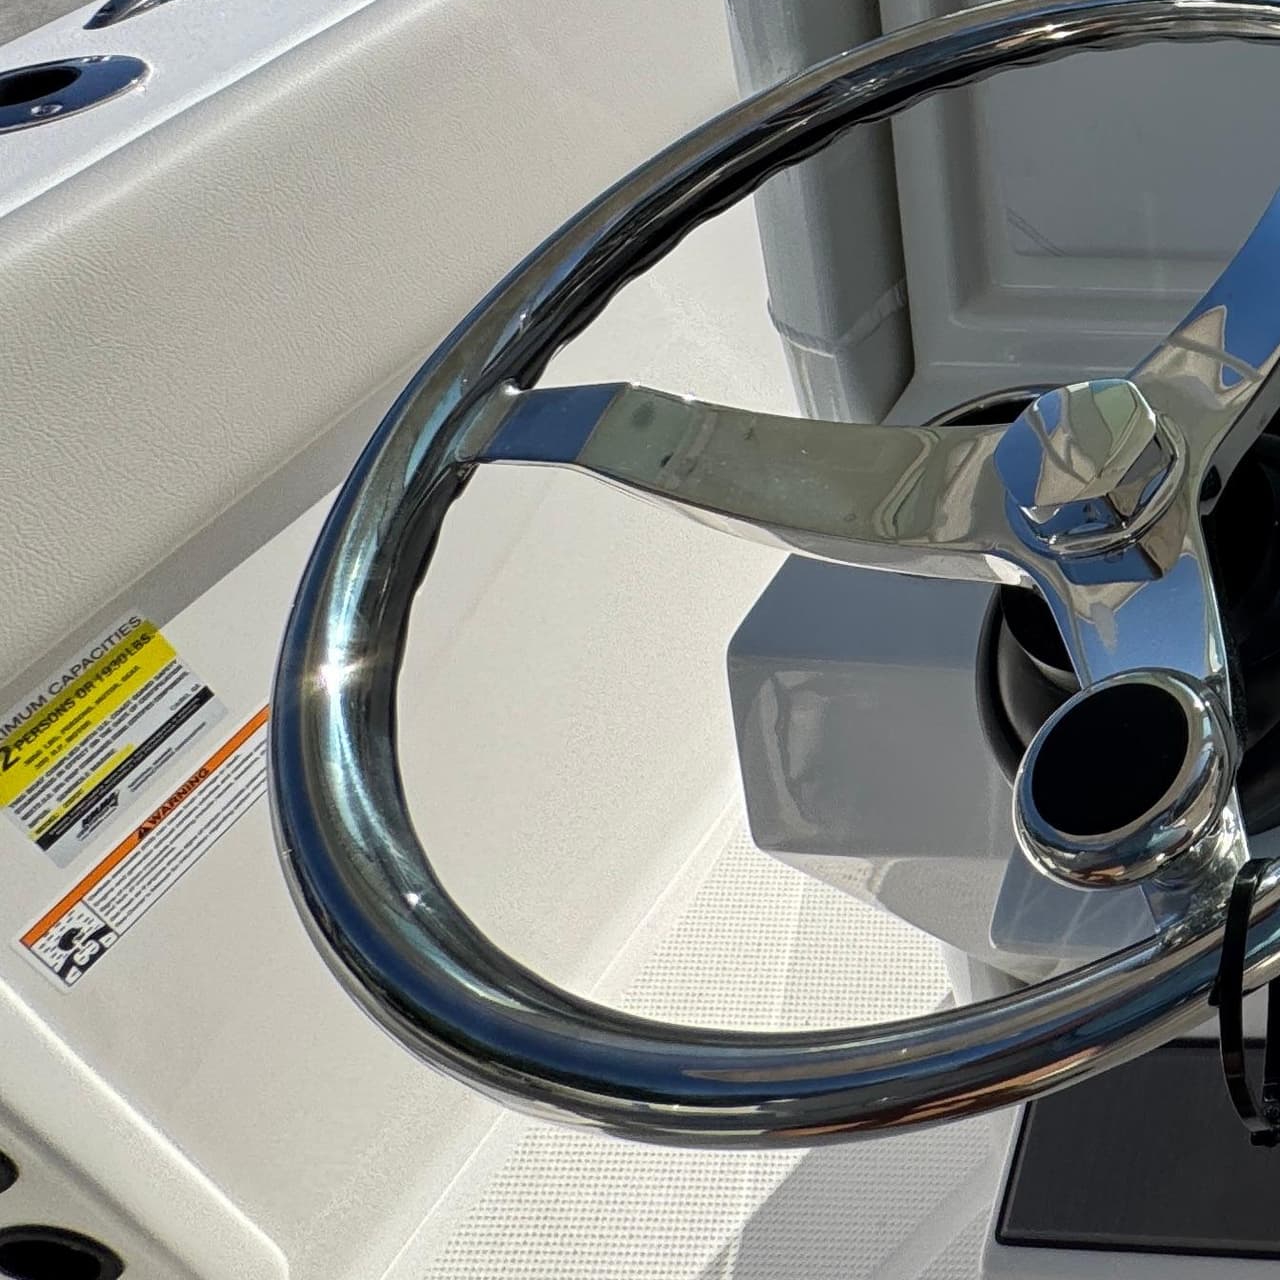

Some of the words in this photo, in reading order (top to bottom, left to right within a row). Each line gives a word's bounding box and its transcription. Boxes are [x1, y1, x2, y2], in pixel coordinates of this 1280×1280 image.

[49, 616, 142, 696] CAPACITIES
[13, 697, 76, 751] PERSONS
[74, 681, 96, 700] OR
[150, 767, 210, 826] WARNING
